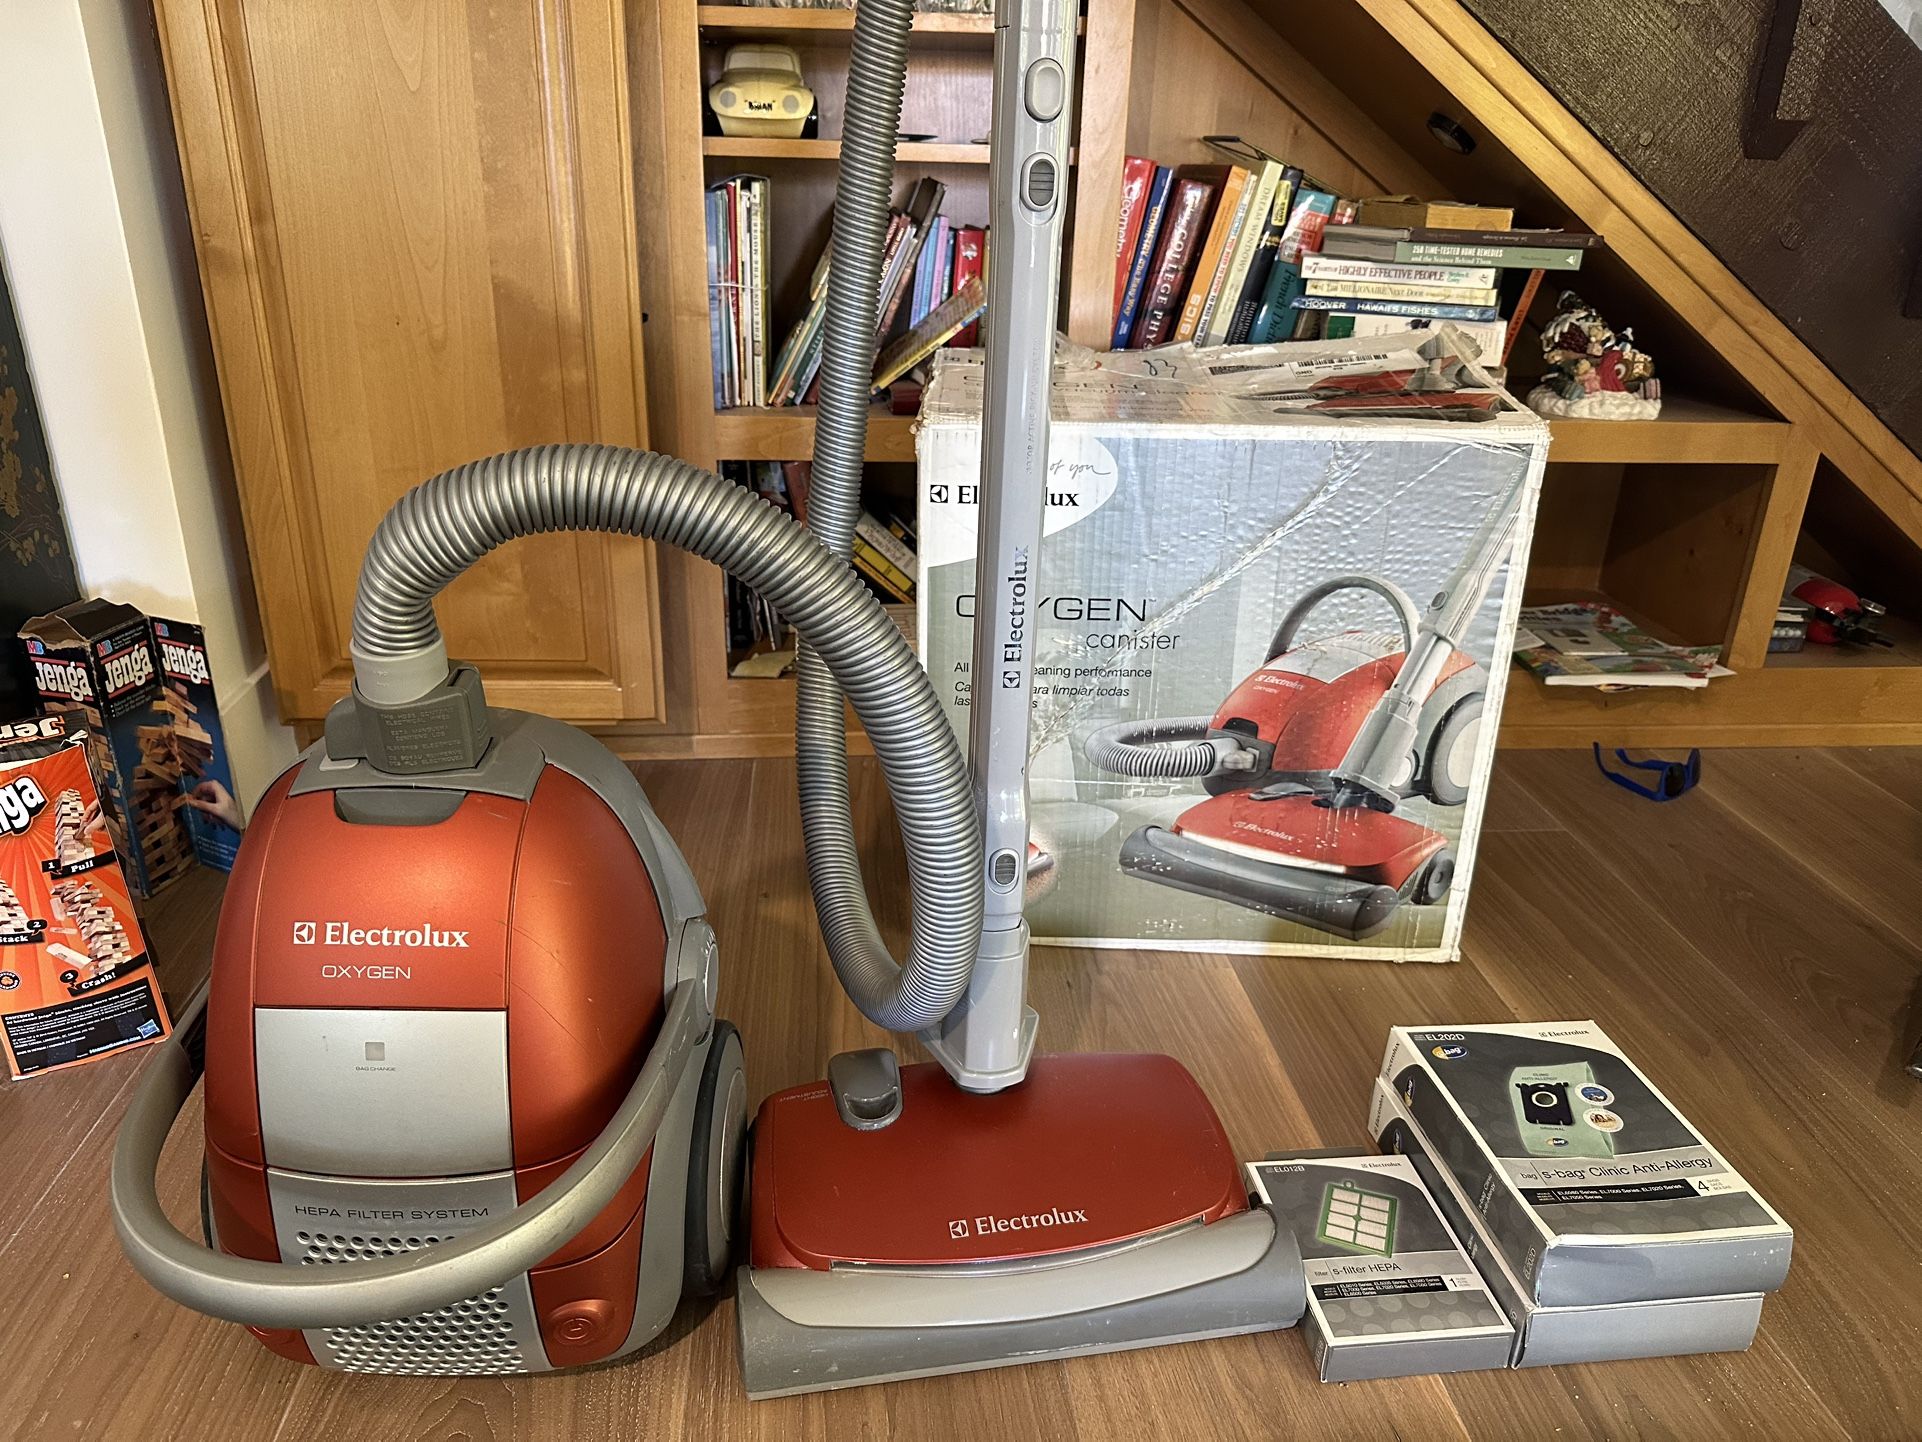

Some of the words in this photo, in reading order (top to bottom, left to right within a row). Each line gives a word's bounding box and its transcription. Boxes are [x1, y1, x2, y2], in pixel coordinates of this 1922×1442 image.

[1156, 230, 1188, 306] COLLEGE
[1339, 265, 1368, 277] HIGHLY
[1369, 267, 1413, 280] EFFECTIVE
[1413, 269, 1446, 281] PEOPLE
[1304, 298, 1347, 310] HOOVER
[1401, 305, 1439, 316] FISHES
[1069, 464, 1112, 480] you
[957, 485, 1080, 507] Ellux
[955, 594, 1148, 622] OGEN
[1003, 545, 1029, 664] Electrolux
[1086, 630, 1181, 650] canister
[104, 643, 154, 694] Jenga
[161, 643, 209, 685] Jenga
[1074, 667, 1153, 679] performance
[34, 661, 94, 702] Jenga
[1263, 676, 1304, 691] Electrolux
[1052, 683, 1093, 697] limpiar
[1095, 686, 1130, 698] todas
[1243, 823, 1295, 842] Electrolux
[70, 859, 95, 874] Pull
[324, 921, 470, 948] Electrolux
[65, 972, 74, 981] 3
[321, 965, 412, 980] OXYGEN
[1425, 1033, 1465, 1041] EL202D
[1548, 1030, 1590, 1038] Electrolux
[1274, 1165, 1305, 1173] EL012B
[1520, 1172, 1538, 1180] bag
[1589, 1164, 1630, 1178] Clinic
[1632, 1155, 1714, 1174] Anti-Allergy
[1698, 1180, 1710, 1192] 4
[294, 1205, 342, 1218] HEPA
[347, 1209, 405, 1220] FILTER
[411, 1207, 489, 1220] SYSTEM
[975, 1207, 1089, 1235] Electrolux
[1332, 1264, 1367, 1276] s-filter
[1368, 1262, 1402, 1274] HEPA
[1449, 1278, 1457, 1288] 1
